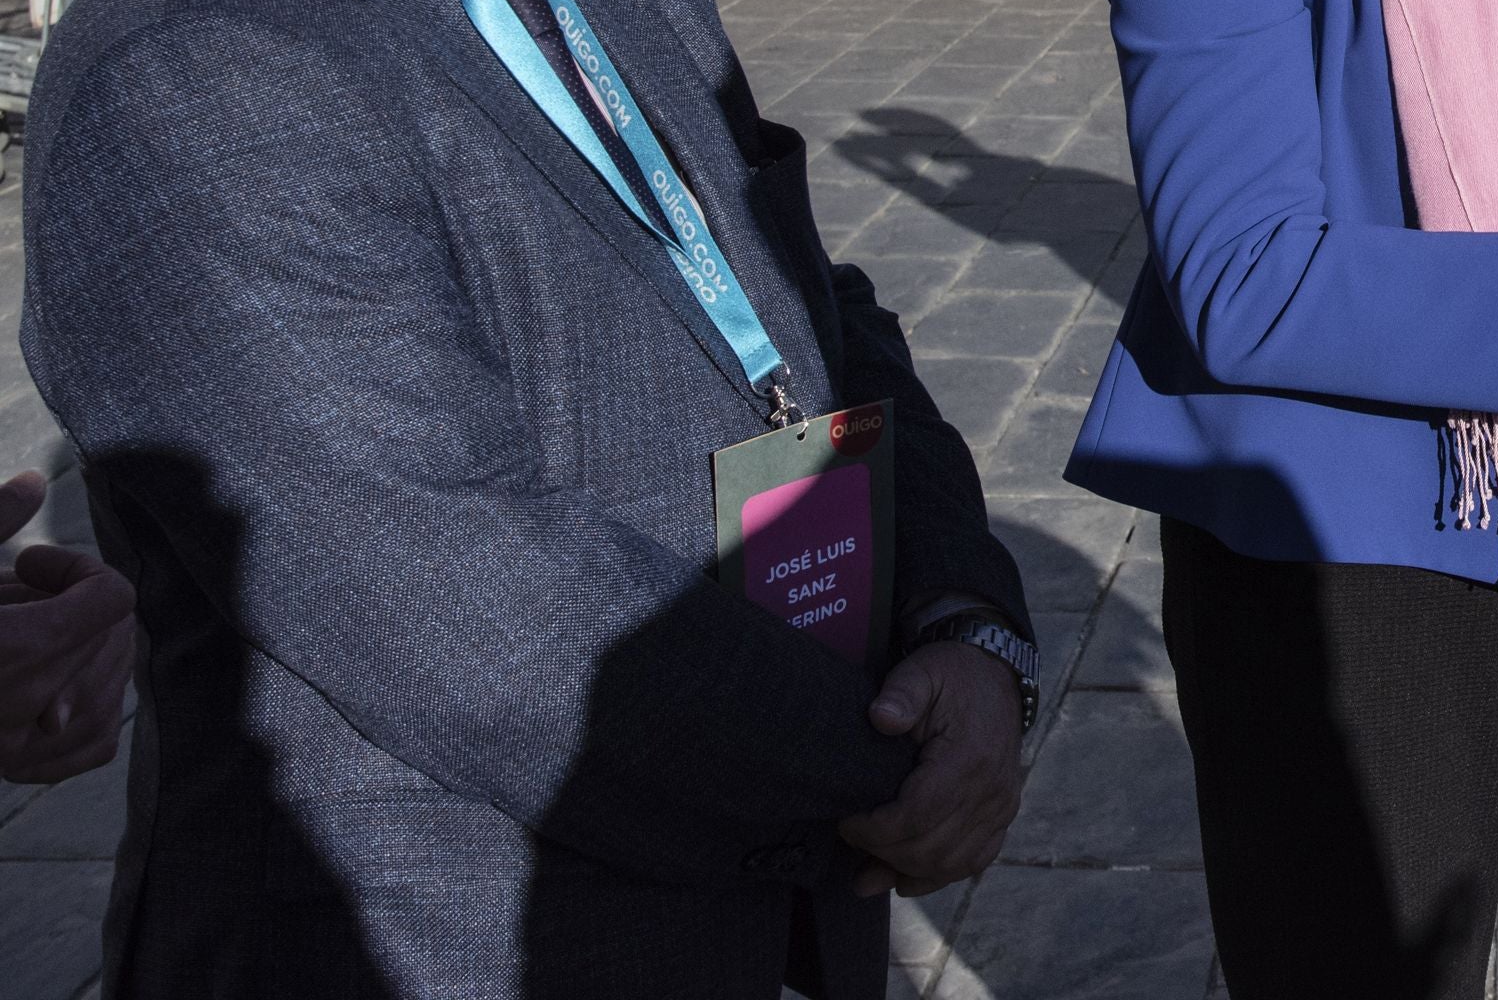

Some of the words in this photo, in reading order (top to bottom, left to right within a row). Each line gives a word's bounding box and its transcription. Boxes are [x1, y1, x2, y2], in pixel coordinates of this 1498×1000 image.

[765, 549, 812, 584] JOSÉ
[816, 537, 857, 565] LUIS
[787, 573, 837, 605] SANZ
[786, 598, 848, 629] ERINO
